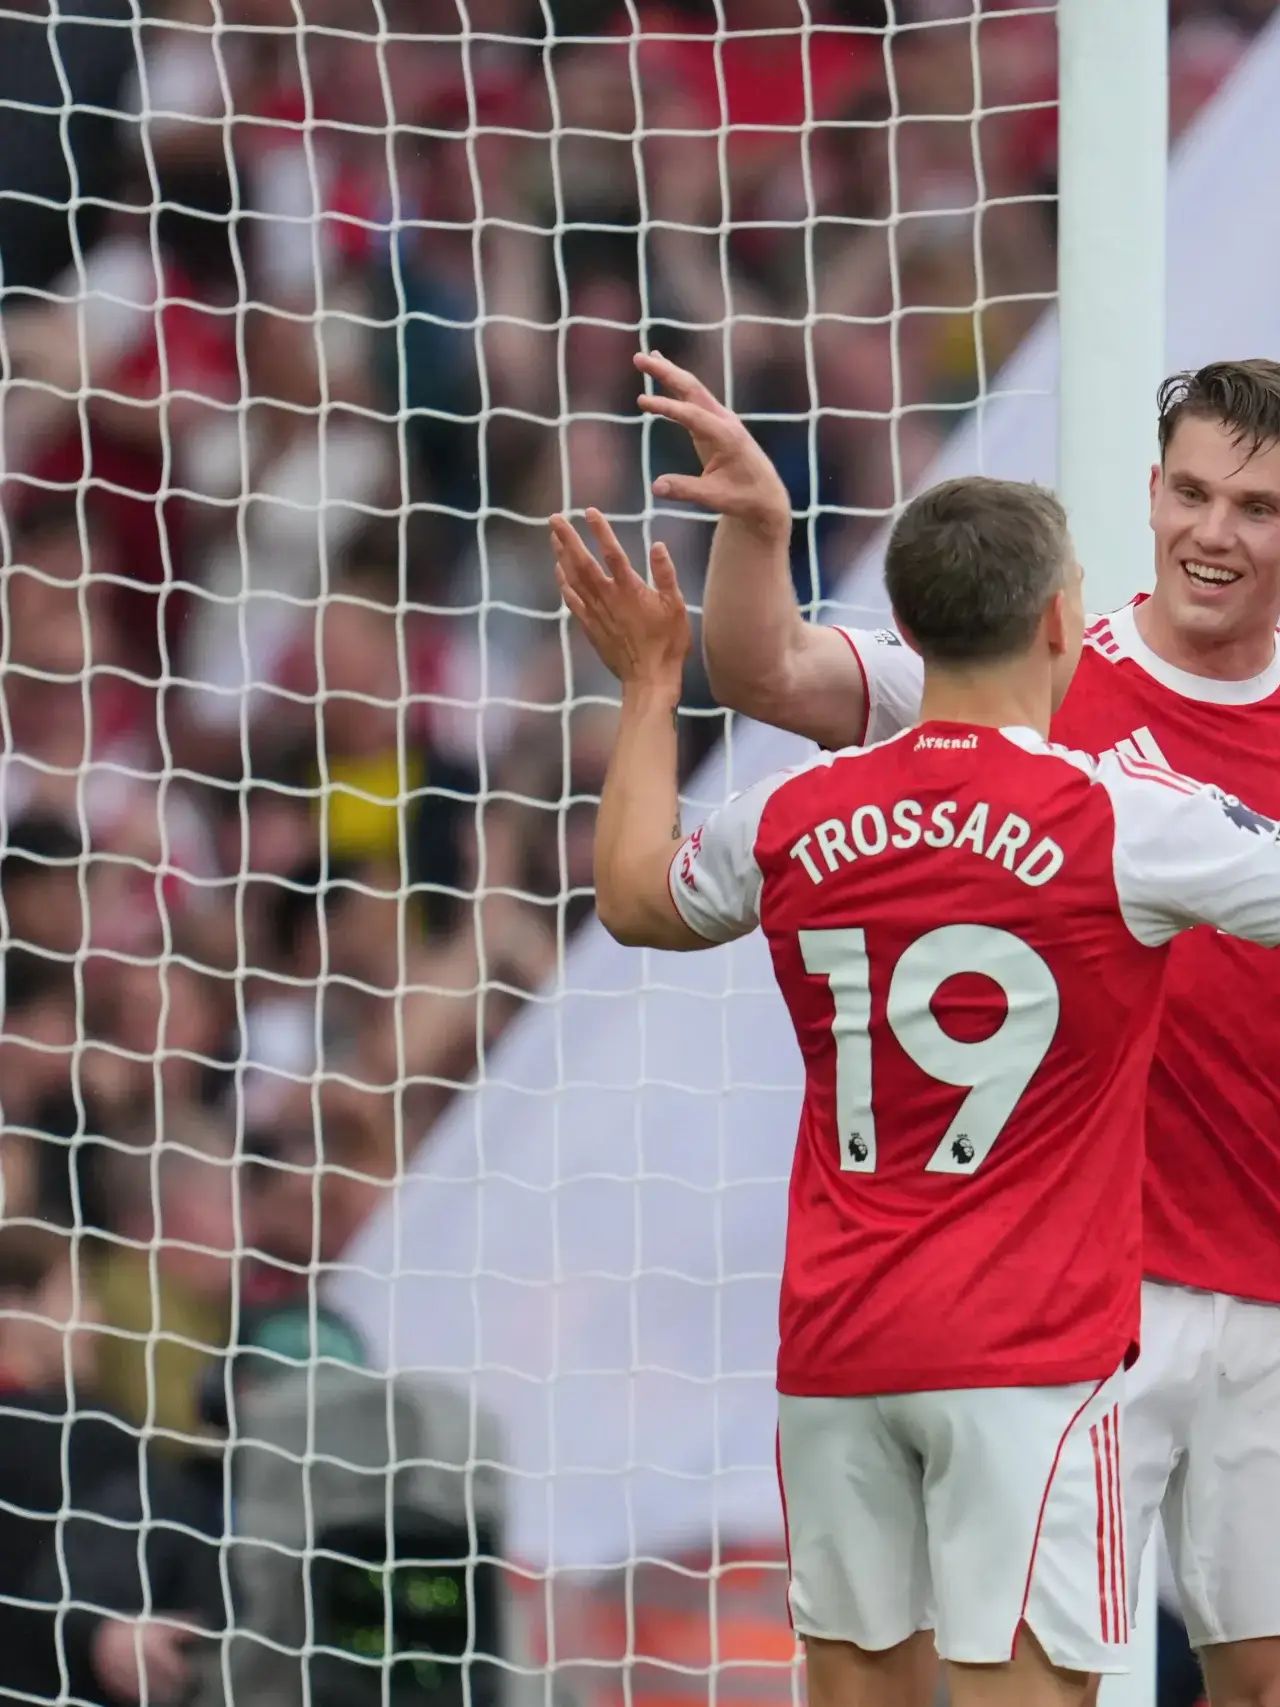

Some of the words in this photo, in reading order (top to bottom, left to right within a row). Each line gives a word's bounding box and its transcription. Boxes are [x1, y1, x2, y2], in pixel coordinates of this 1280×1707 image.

[913, 733, 979, 752] Arsenal
[789, 799, 1064, 887] TROSSARD
[797, 924, 1061, 1174] 19
